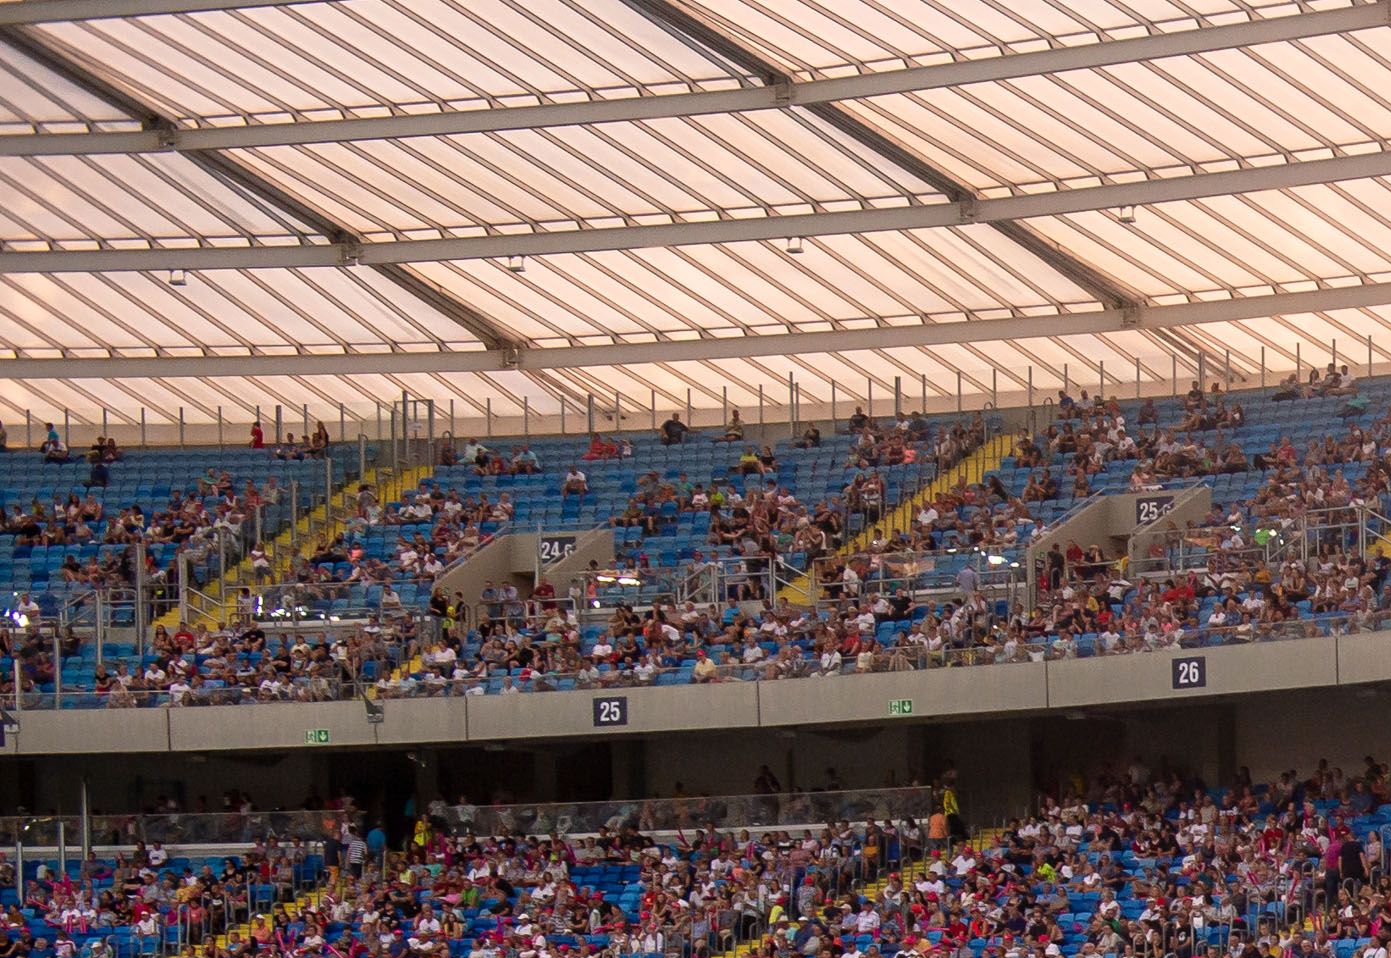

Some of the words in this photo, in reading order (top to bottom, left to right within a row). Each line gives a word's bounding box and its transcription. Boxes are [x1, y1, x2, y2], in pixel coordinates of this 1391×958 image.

[1139, 502, 1157, 521] 25
[541, 541, 560, 559] 24
[1179, 661, 1199, 684] 26
[600, 701, 620, 722] 25
